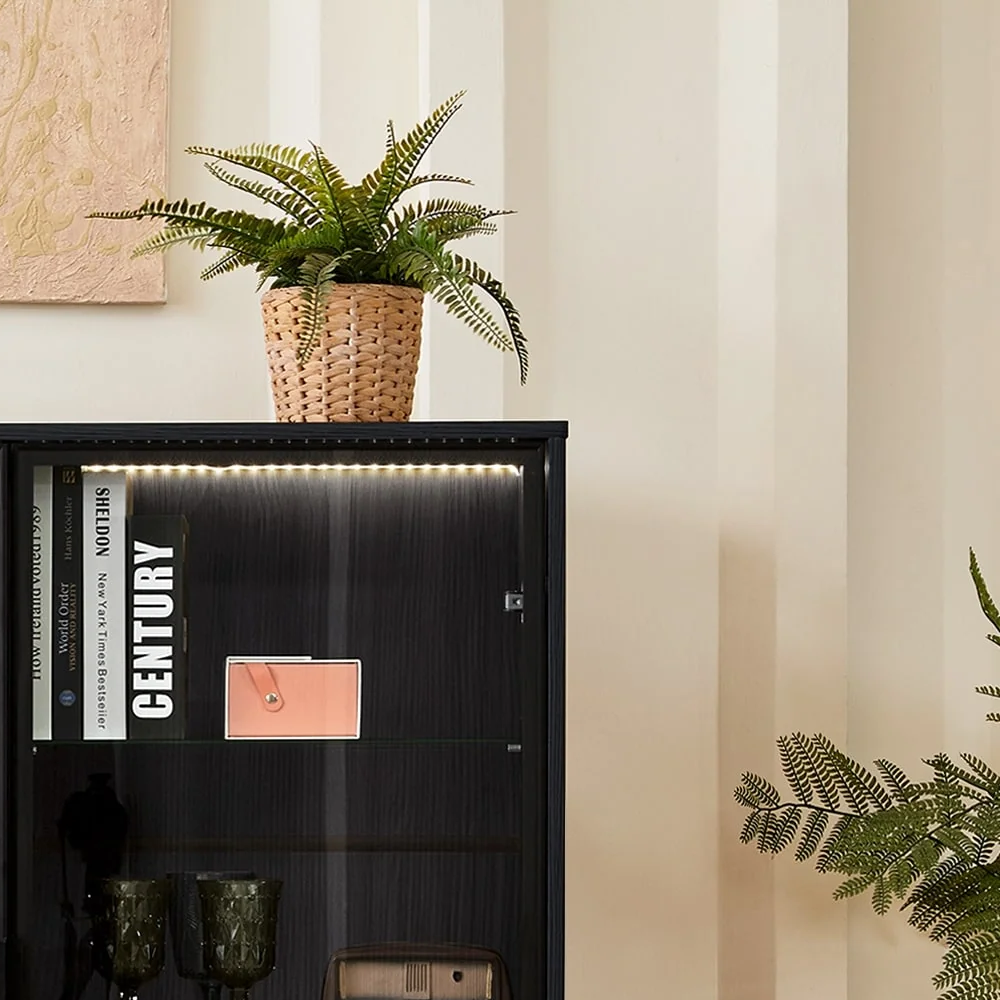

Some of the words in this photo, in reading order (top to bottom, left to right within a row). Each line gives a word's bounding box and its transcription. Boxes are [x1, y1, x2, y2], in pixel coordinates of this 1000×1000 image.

[95, 488, 110, 556] SHELDON
[64, 536, 72, 560] Hans
[58, 582, 68, 616] Order
[98, 572, 108, 598] New
[58, 620, 68, 654] World
[132, 540, 173, 719] CENTURY
[98, 630, 108, 666] Times
